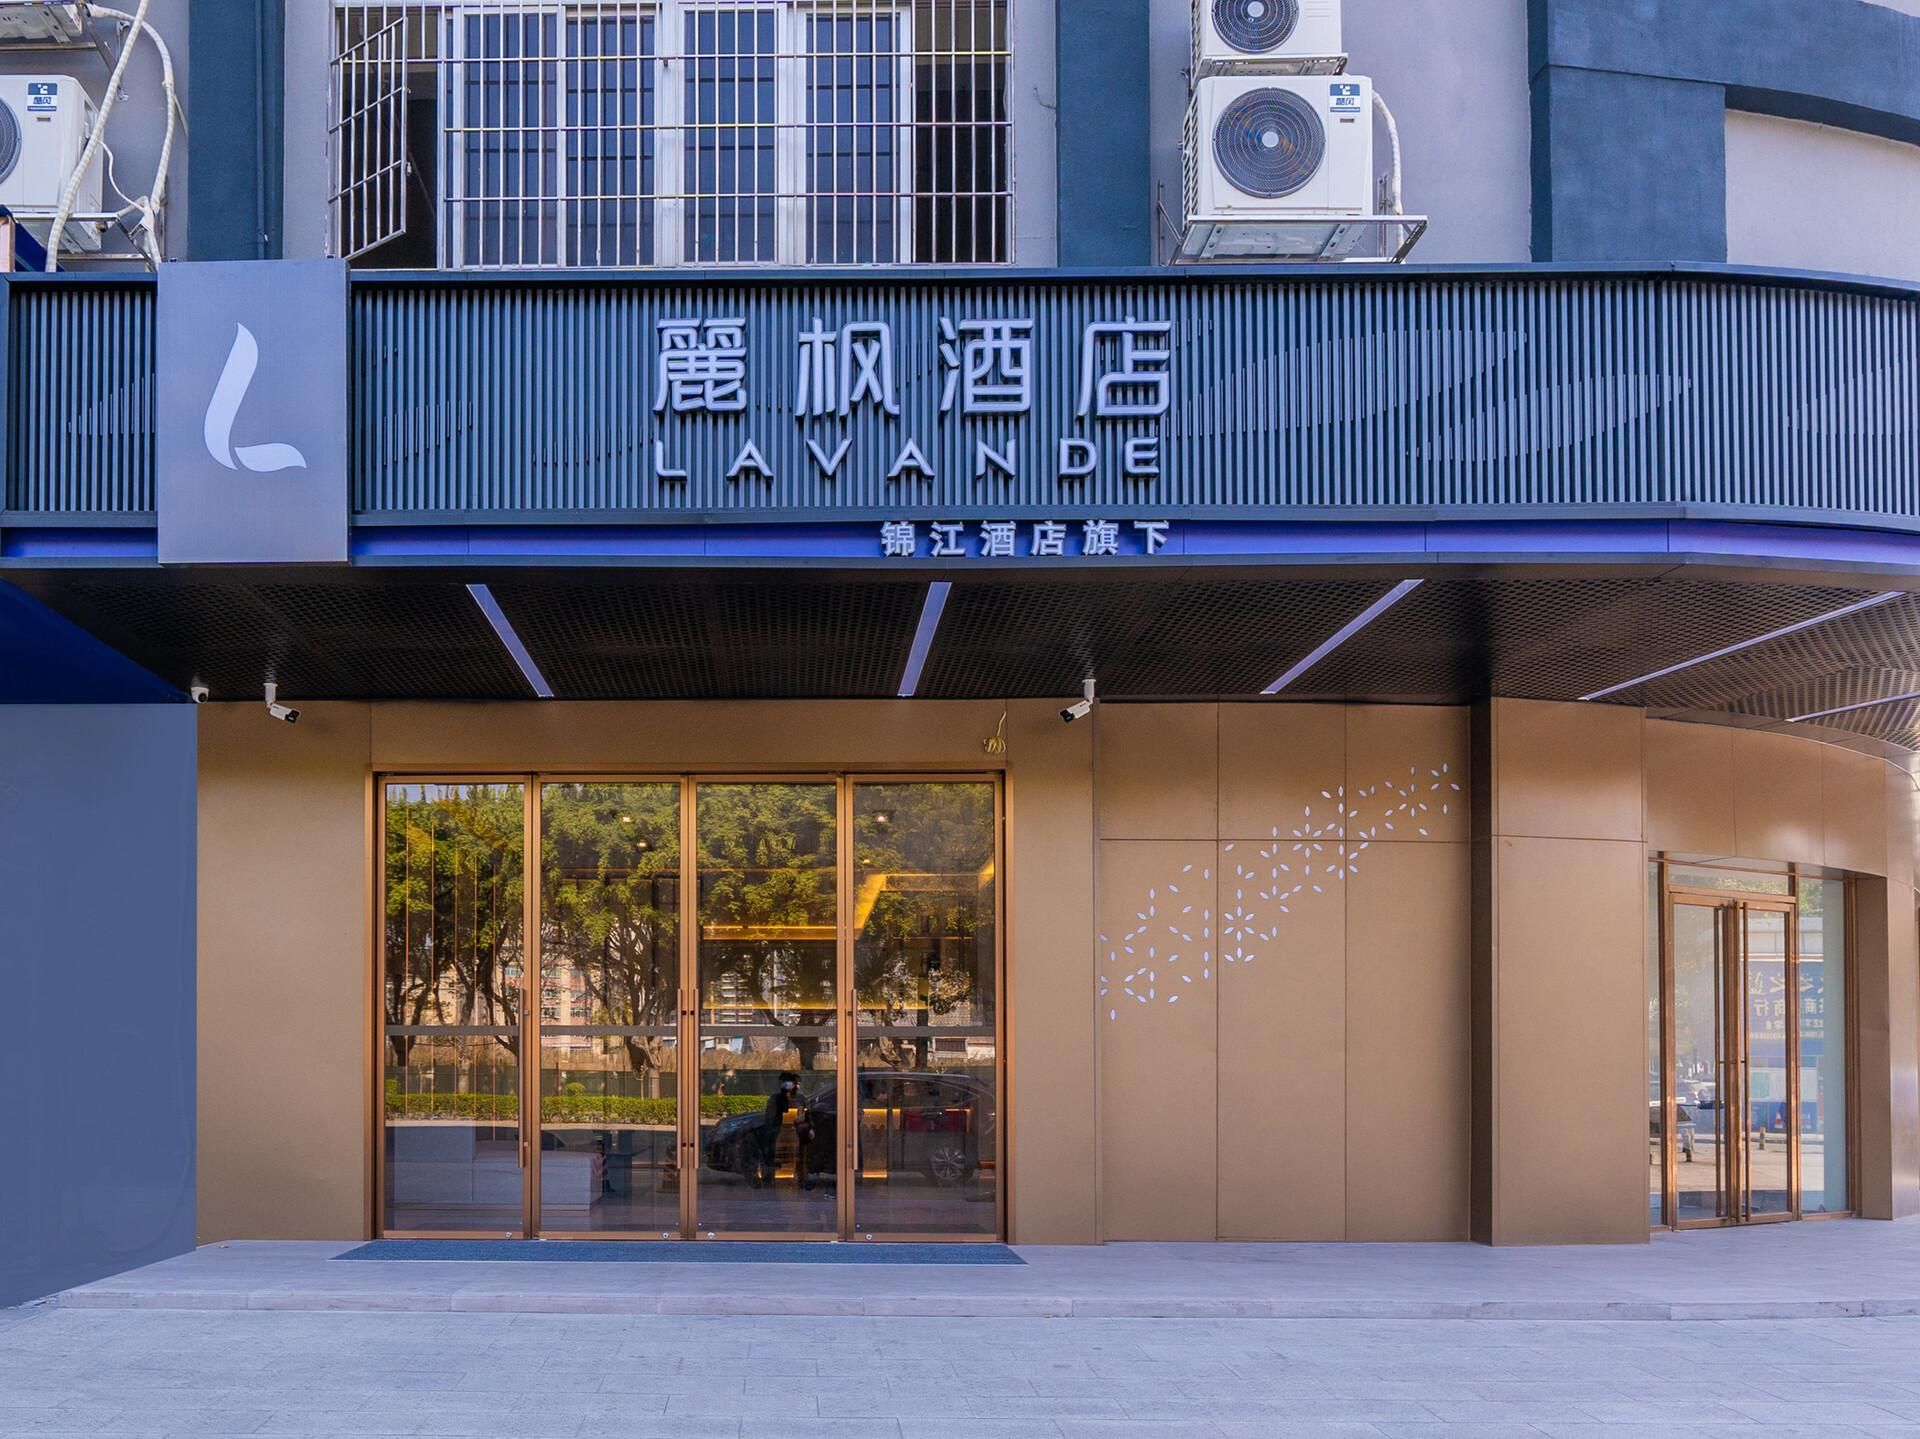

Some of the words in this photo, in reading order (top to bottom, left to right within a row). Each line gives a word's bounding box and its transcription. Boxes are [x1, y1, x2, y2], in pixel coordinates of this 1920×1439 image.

[653, 316, 1172, 418] 麗枫酒店
[655, 437, 1160, 479] LAVANDE
[880, 520, 1171, 557] 锦江酒店旗下
